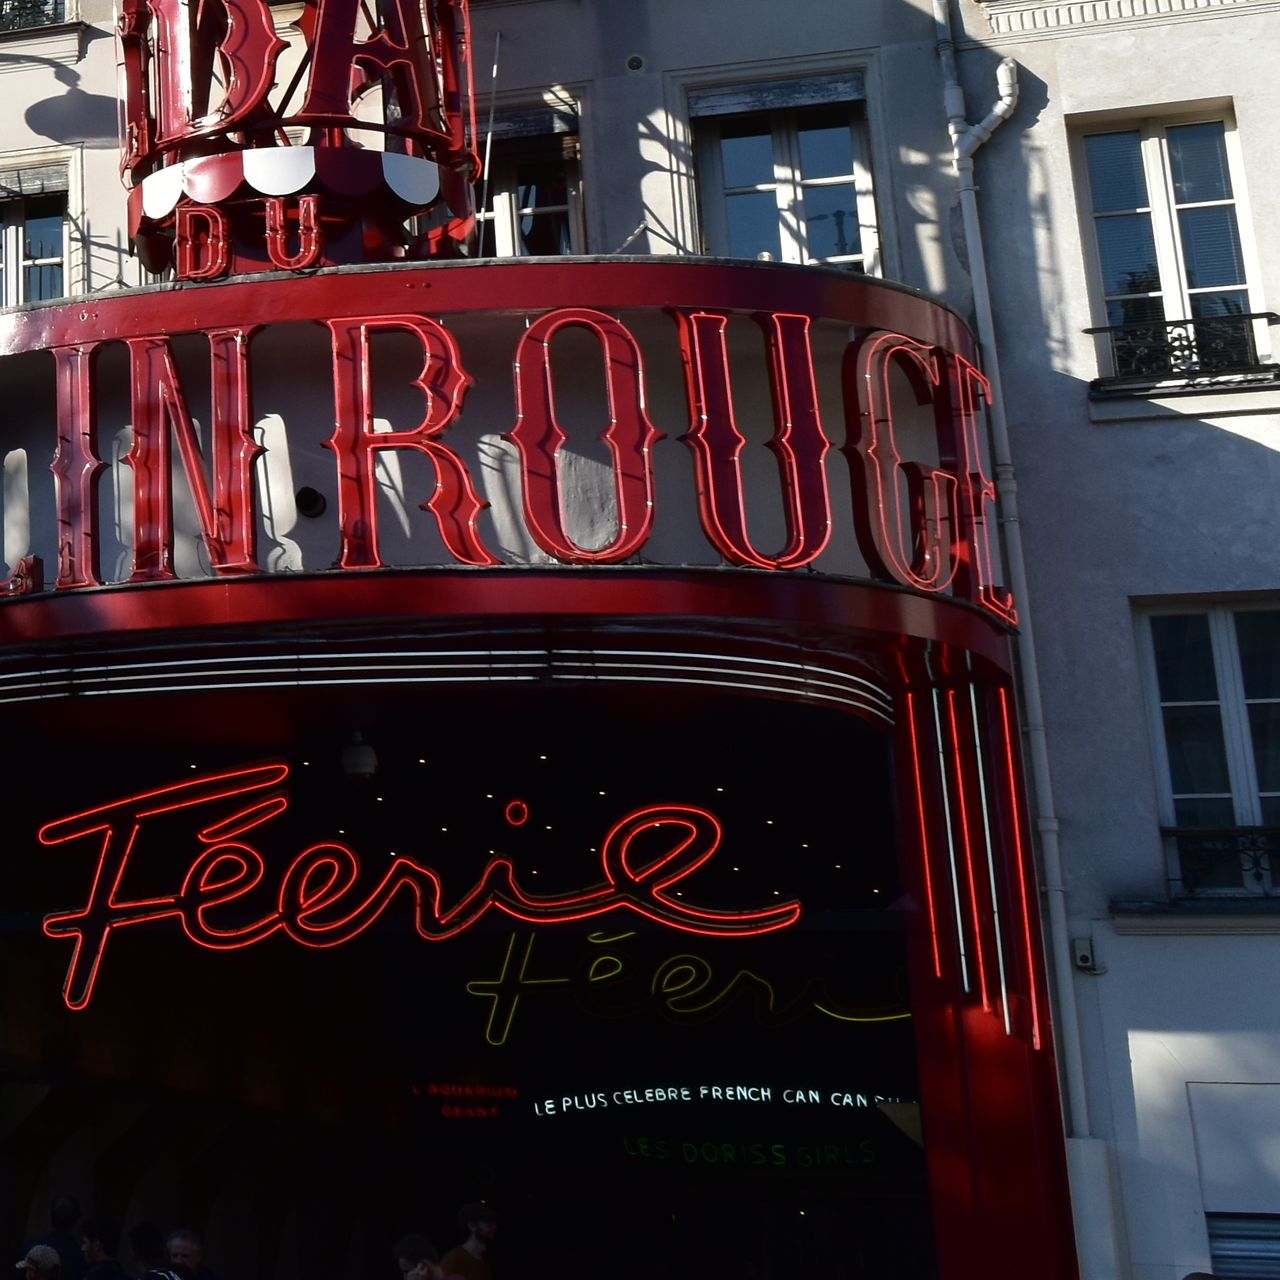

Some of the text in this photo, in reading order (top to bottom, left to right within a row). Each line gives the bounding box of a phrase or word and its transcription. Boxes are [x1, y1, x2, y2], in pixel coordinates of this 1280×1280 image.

[174, 195, 322, 282] DU
[322, 308, 1018, 626] ROUGE
[39, 763, 802, 1010] Féerie
[534, 1094, 556, 1116] LE
[562, 1091, 608, 1113] PLUS
[612, 1086, 692, 1108] CELEBRE
[699, 1085, 771, 1104] FRENCH
[783, 1088, 821, 1105] CAN
[830, 1091, 868, 1109] CAN
